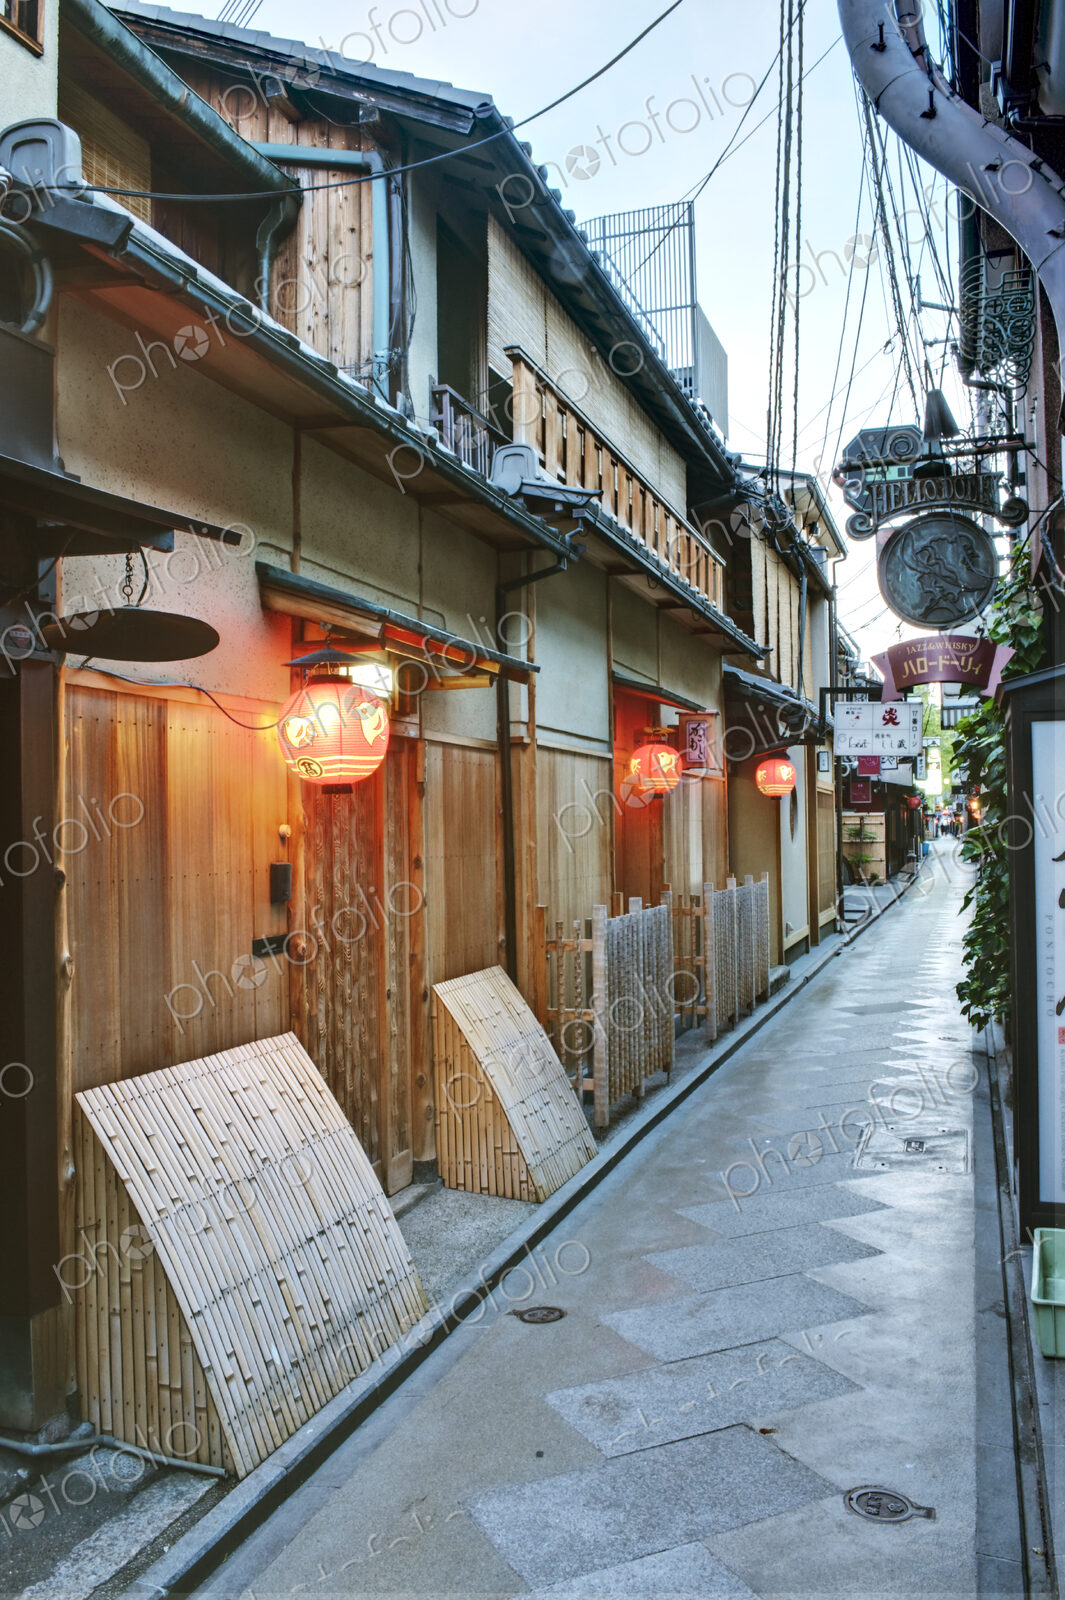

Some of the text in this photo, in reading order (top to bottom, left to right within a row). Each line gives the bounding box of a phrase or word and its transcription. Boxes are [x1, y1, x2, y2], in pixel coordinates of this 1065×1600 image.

[902, 655, 982, 679] ハロードーリィ
[882, 707, 901, 726] 炎
[1044, 913, 1055, 1017] PONTOCHO
